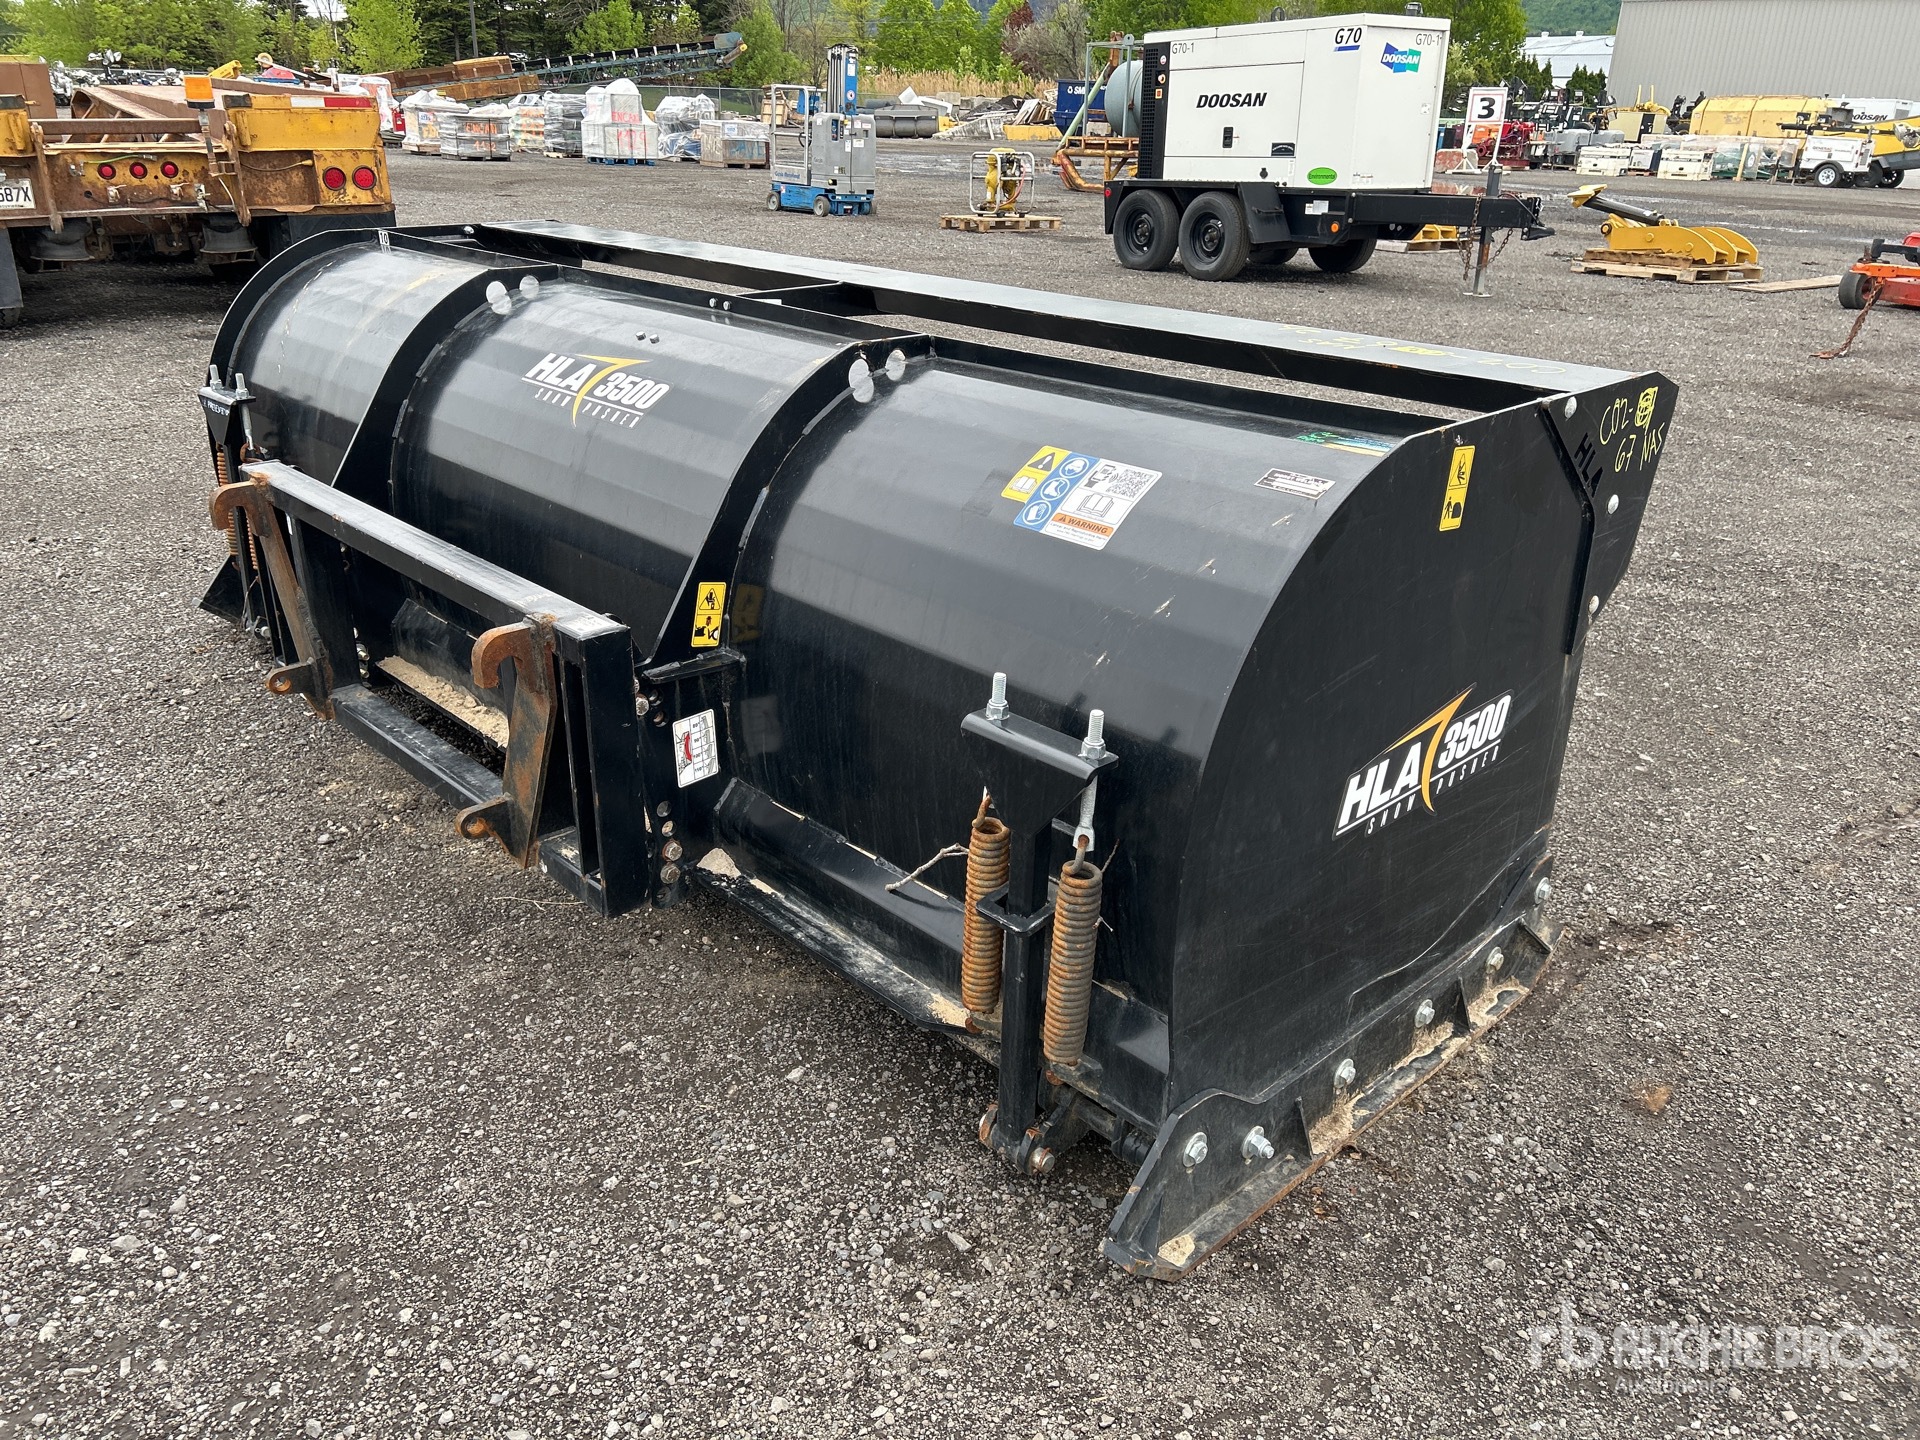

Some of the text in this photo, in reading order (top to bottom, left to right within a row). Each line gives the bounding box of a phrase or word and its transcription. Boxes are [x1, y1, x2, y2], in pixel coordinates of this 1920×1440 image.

[1335, 27, 1362, 45] G70
[1415, 33, 1440, 46] G70-1
[1171, 42, 1195, 54] G70-1
[1381, 53, 1420, 64] DOOSAN
[1196, 92, 1268, 108] DOOSAN
[1477, 97, 1496, 119] 3
[1852, 114, 1888, 122] OOSAN
[525, 353, 670, 409] HLA 3500
[534, 388, 639, 428] SNOW PUSHER
[1574, 432, 1604, 498] HLA
[1067, 517, 1108, 534] WARNING
[1338, 695, 1511, 828] HLA 3500
[1367, 745, 1499, 834] SNOW PUSHER
